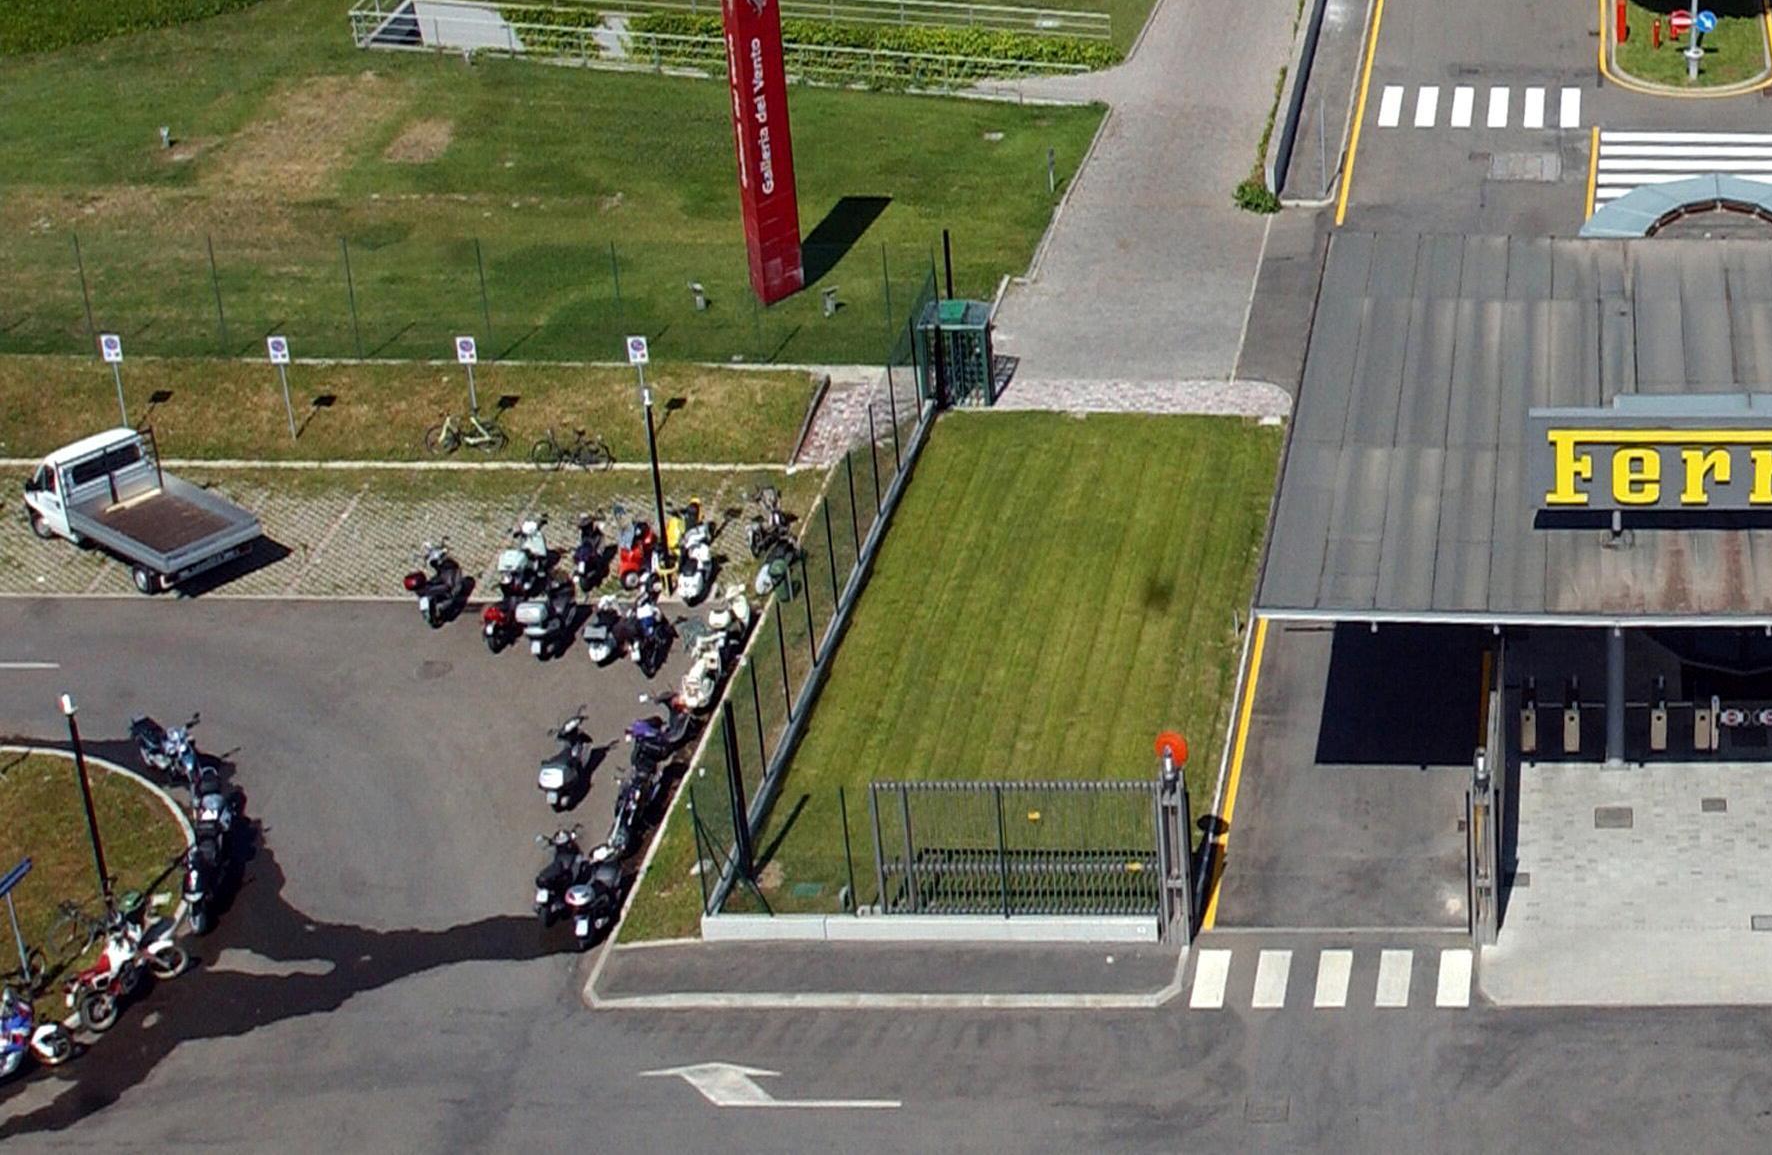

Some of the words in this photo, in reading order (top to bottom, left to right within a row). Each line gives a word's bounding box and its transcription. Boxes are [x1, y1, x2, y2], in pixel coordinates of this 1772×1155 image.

[751, 38, 766, 93] Vento
[754, 94, 767, 123] del
[757, 126, 774, 194] Galleria
